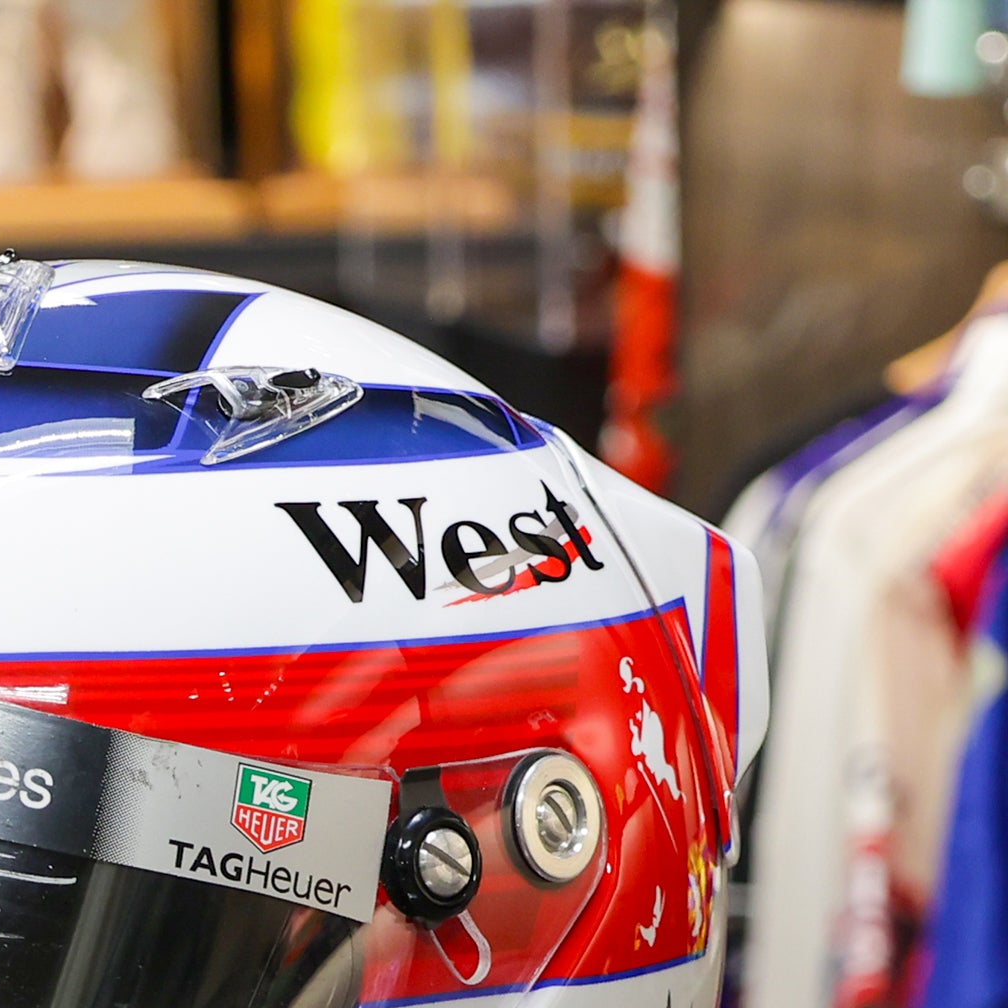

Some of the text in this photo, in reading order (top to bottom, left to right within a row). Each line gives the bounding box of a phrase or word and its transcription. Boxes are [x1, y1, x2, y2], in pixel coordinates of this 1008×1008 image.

[275, 479, 605, 604] West
[251, 774, 299, 813] TAG
[238, 808, 299, 845] HEUER
[169, 838, 352, 909] TAGHeuer
